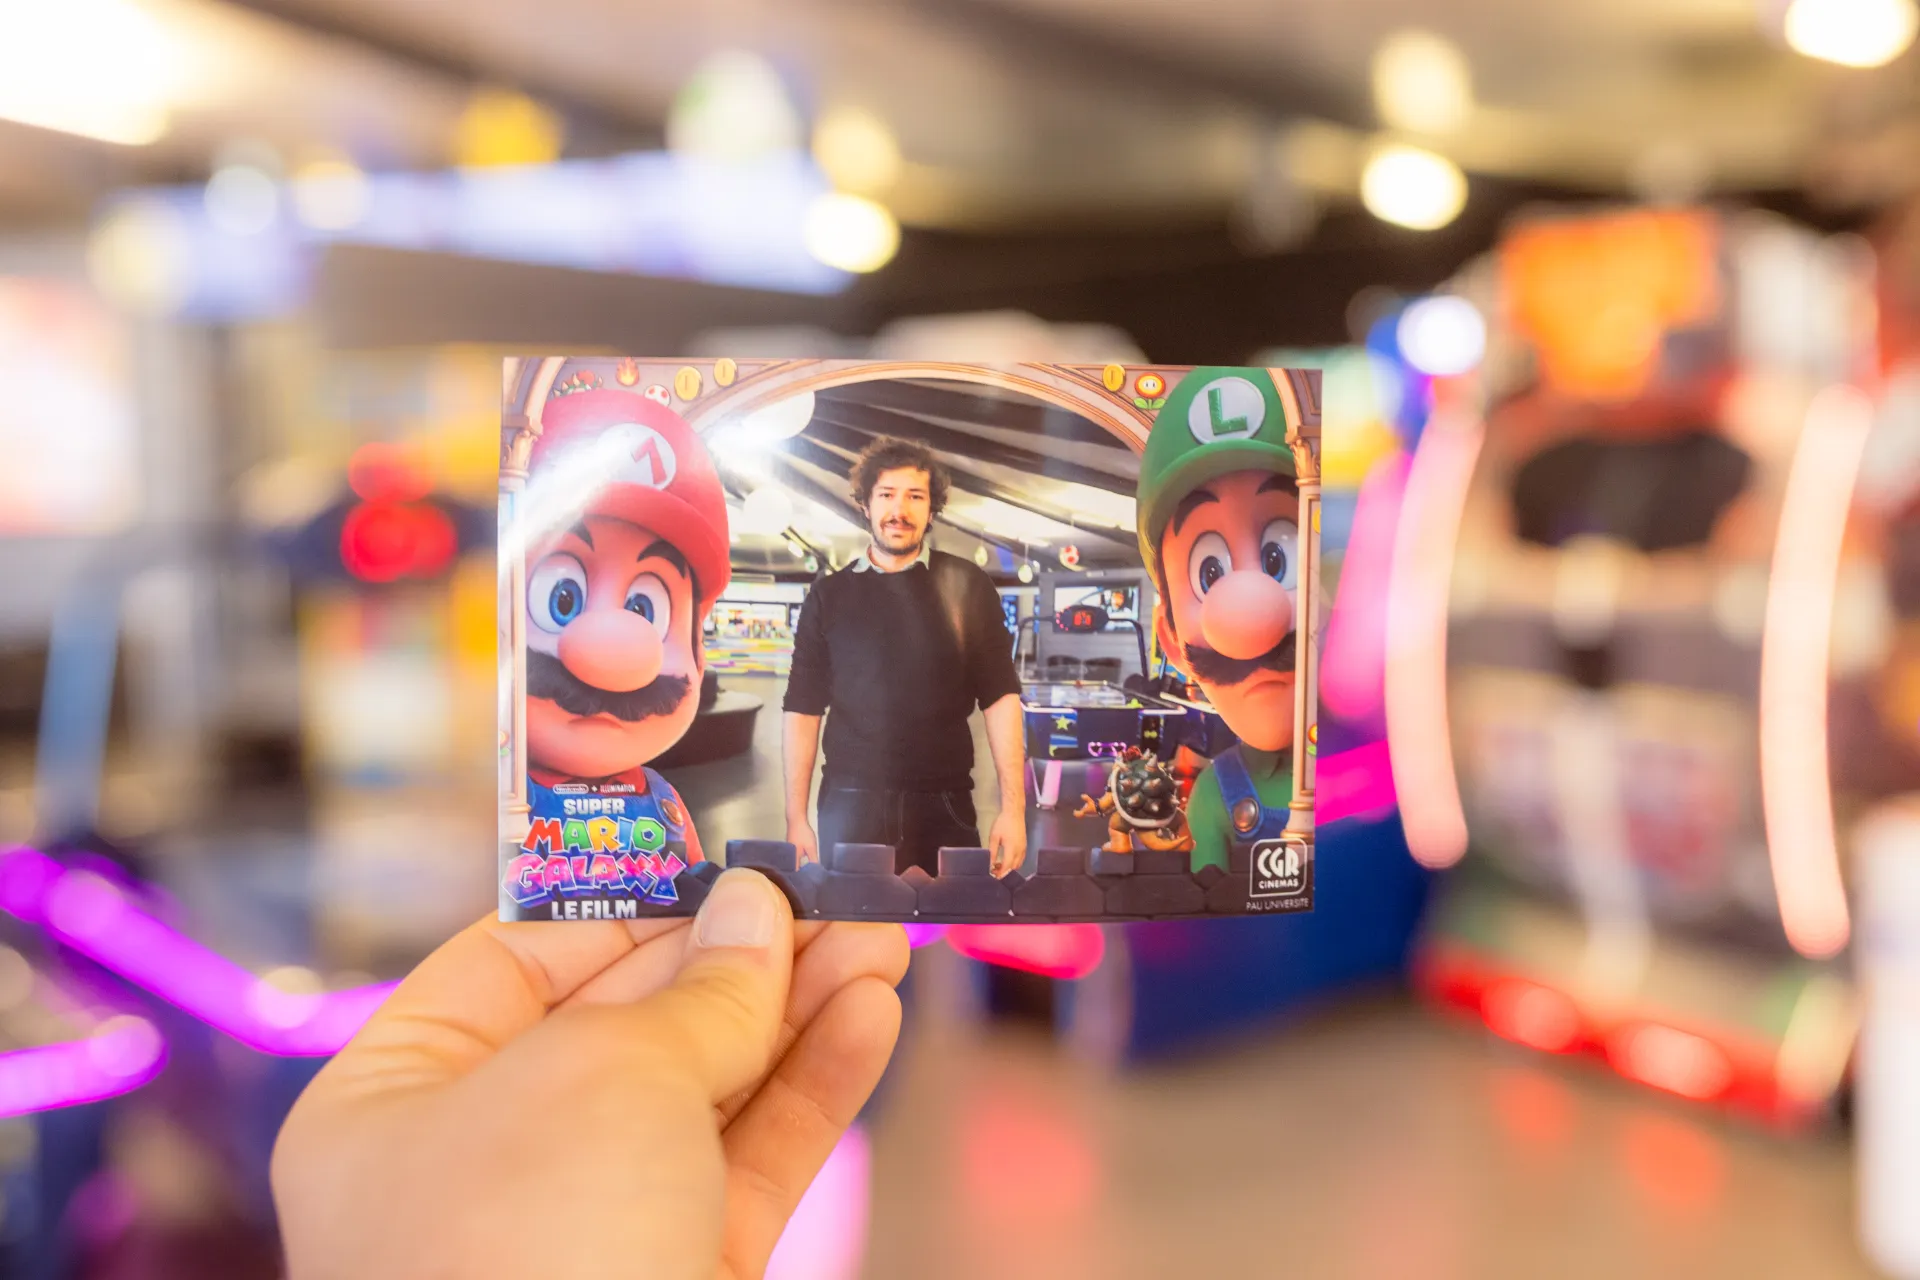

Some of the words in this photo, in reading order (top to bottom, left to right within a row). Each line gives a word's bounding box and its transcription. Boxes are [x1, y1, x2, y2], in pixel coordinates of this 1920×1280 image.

[1207, 387, 1249, 436] L
[563, 798, 626, 815] SUPER
[521, 816, 667, 855] MARIO
[1257, 847, 1300, 878] CGR
[502, 851, 687, 905] GALAXY
[1258, 879, 1299, 889] CINEMAS
[551, 901, 577, 920] LE
[581, 899, 637, 919] FILM
[1246, 901, 1262, 911] PAU
